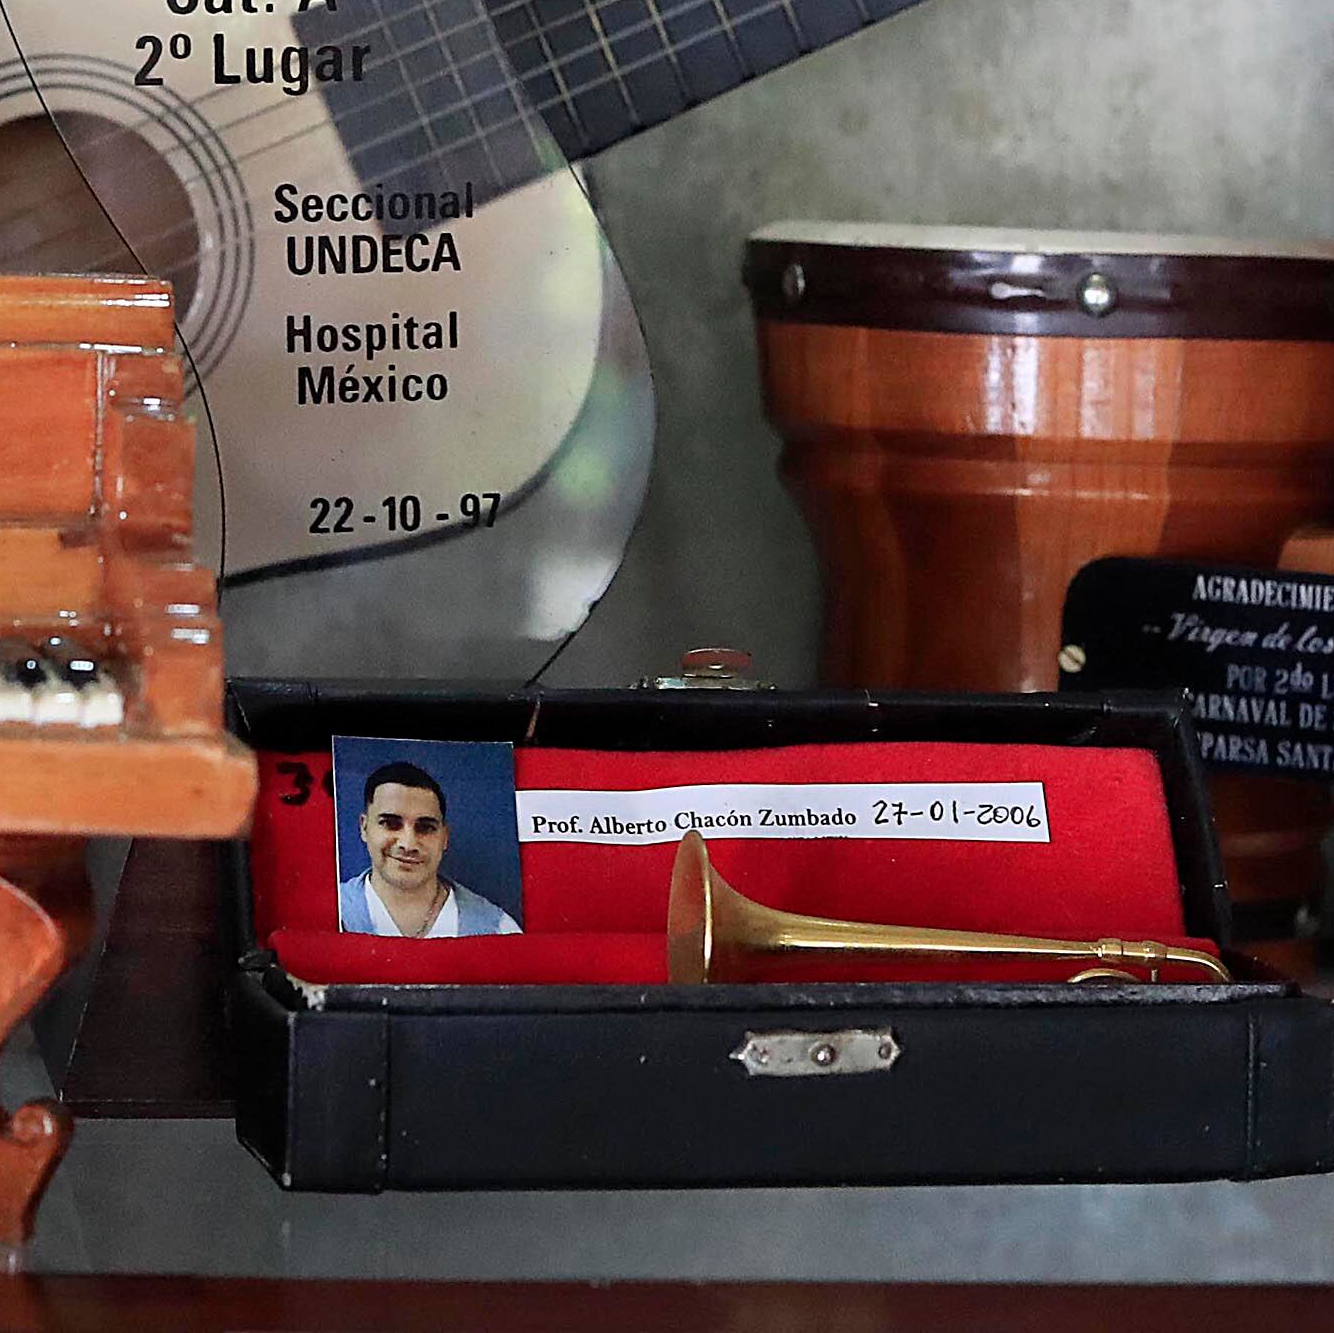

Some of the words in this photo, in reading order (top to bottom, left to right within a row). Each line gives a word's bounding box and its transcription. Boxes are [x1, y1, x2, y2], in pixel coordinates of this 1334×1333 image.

[214, 33, 371, 97] Lugar
[275, 183, 474, 224] Seccional
[286, 232, 461, 275] UNDECA
[286, 312, 459, 357] Hospital
[298, 364, 449, 406] México
[1262, 622, 1292, 651] de
[1226, 664, 1268, 692] POR
[1274, 661, 1315, 695] 2do
[1190, 691, 1291, 727] ARNAVAL
[1299, 702, 1328, 731] DE
[1196, 730, 1268, 765] PARSA
[532, 814, 583, 835] Prof.
[589, 813, 667, 834] Alberto
[674, 809, 752, 830] Chacón
[759, 808, 857, 827] Zumbado
[871, 798, 1042, 828] 27-01-2006
